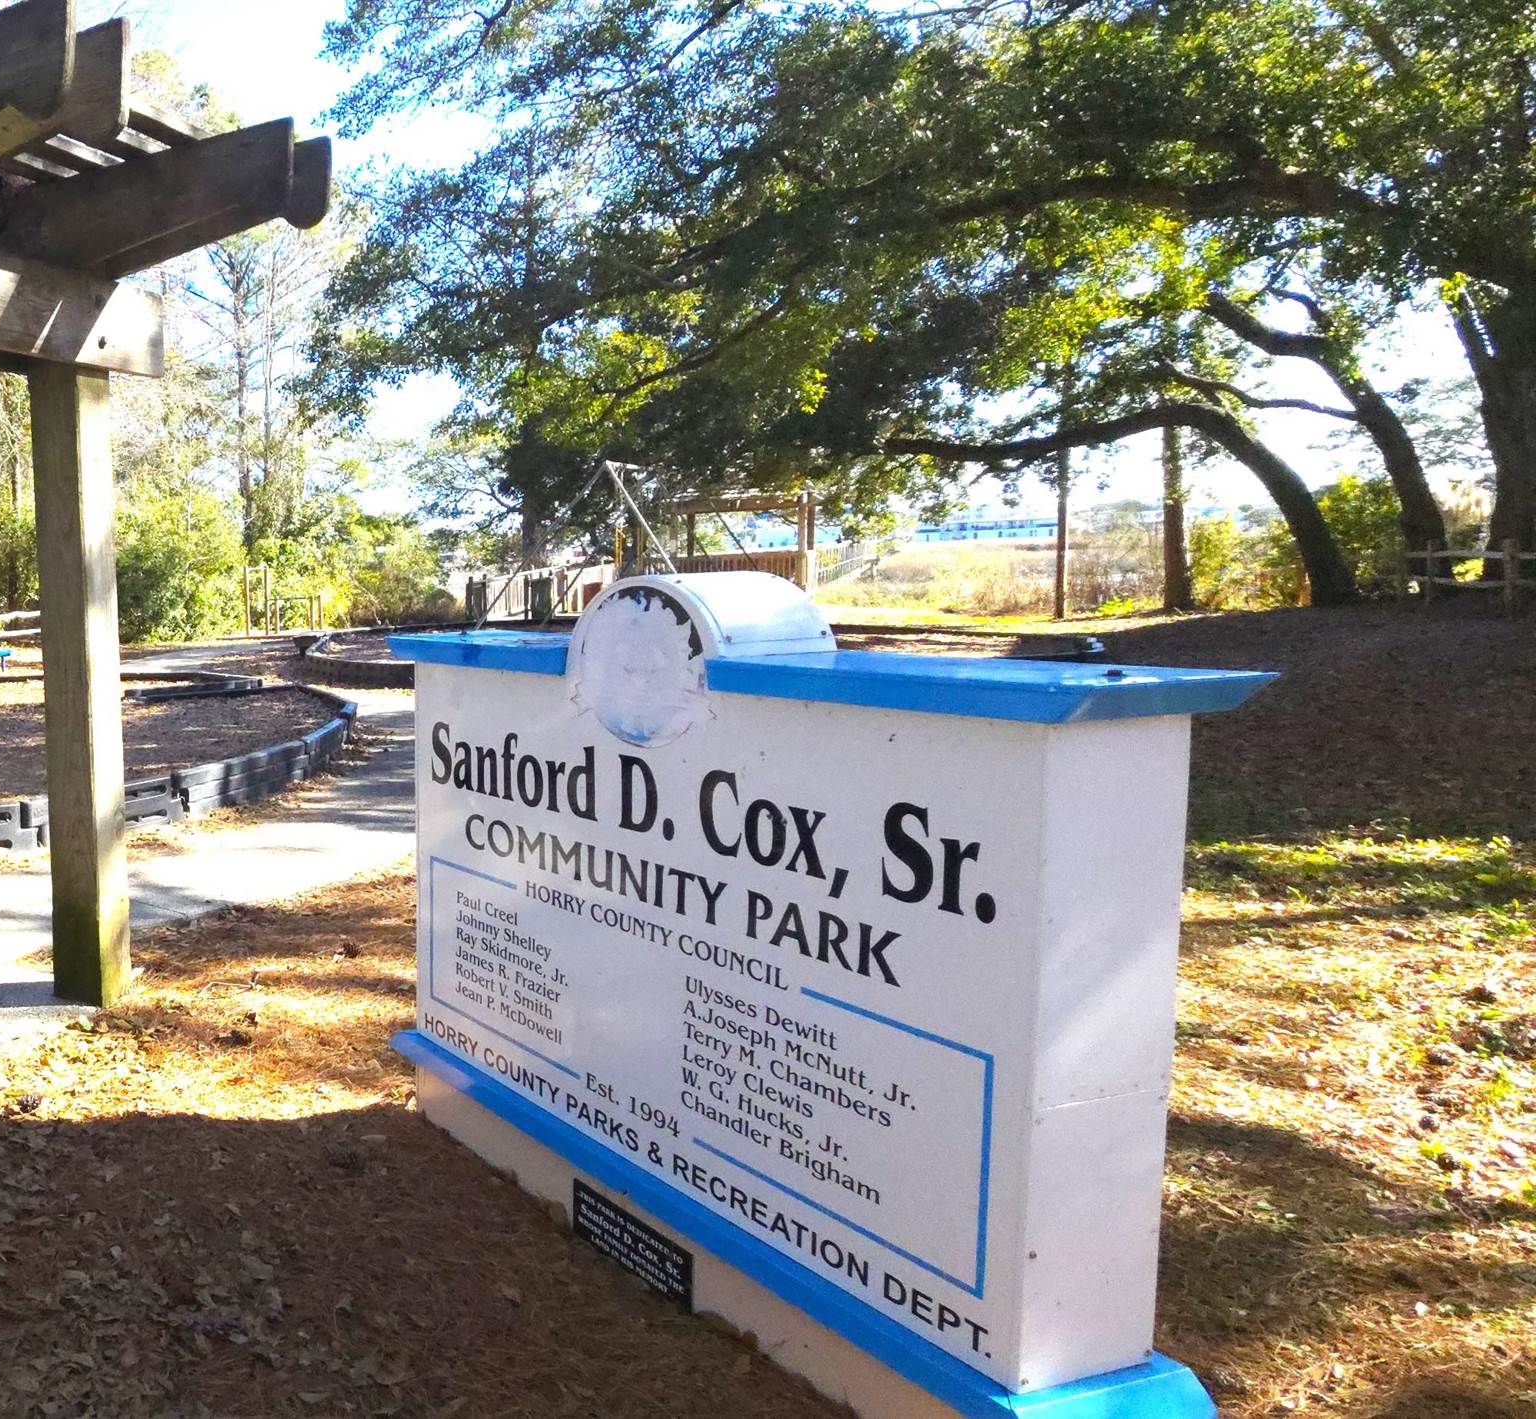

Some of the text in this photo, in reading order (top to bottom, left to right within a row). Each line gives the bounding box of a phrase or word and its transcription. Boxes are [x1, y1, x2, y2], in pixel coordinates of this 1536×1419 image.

[431, 721, 996, 924] Sanford D. Cox, Sr.
[456, 891, 518, 926] Paul Creel
[456, 910, 551, 962] Johnny Shelley
[465, 814, 902, 987] COMMUNITY PARK
[525, 880, 789, 991] HORRY COUNTY COUNCIL
[456, 927, 568, 986] Ray Skidmore, Jr.
[456, 946, 561, 1003] James R. Frazier
[456, 962, 552, 1020] Robert V. Smith
[455, 981, 562, 1045] Jean P. McDowell
[685, 976, 838, 1050] Ulysses Dewitt
[683, 1000, 916, 1111] A.Joseph McNutt, Jr.
[683, 1021, 892, 1127] Terry M. Chambers
[683, 1045, 814, 1118] Leroy Clewis
[586, 1072, 681, 1138] Est. 1994
[682, 1067, 848, 1162] W. G. Hucks, Jr.
[681, 1090, 881, 1205] Chandler Brigham
[424, 1013, 993, 1359] HORRY COUNTY PARKS & RECREATION DEPT.
[581, 1203, 681, 1279] Sanford D. Cox, Sr.
[673, 1253, 683, 1264] TO
